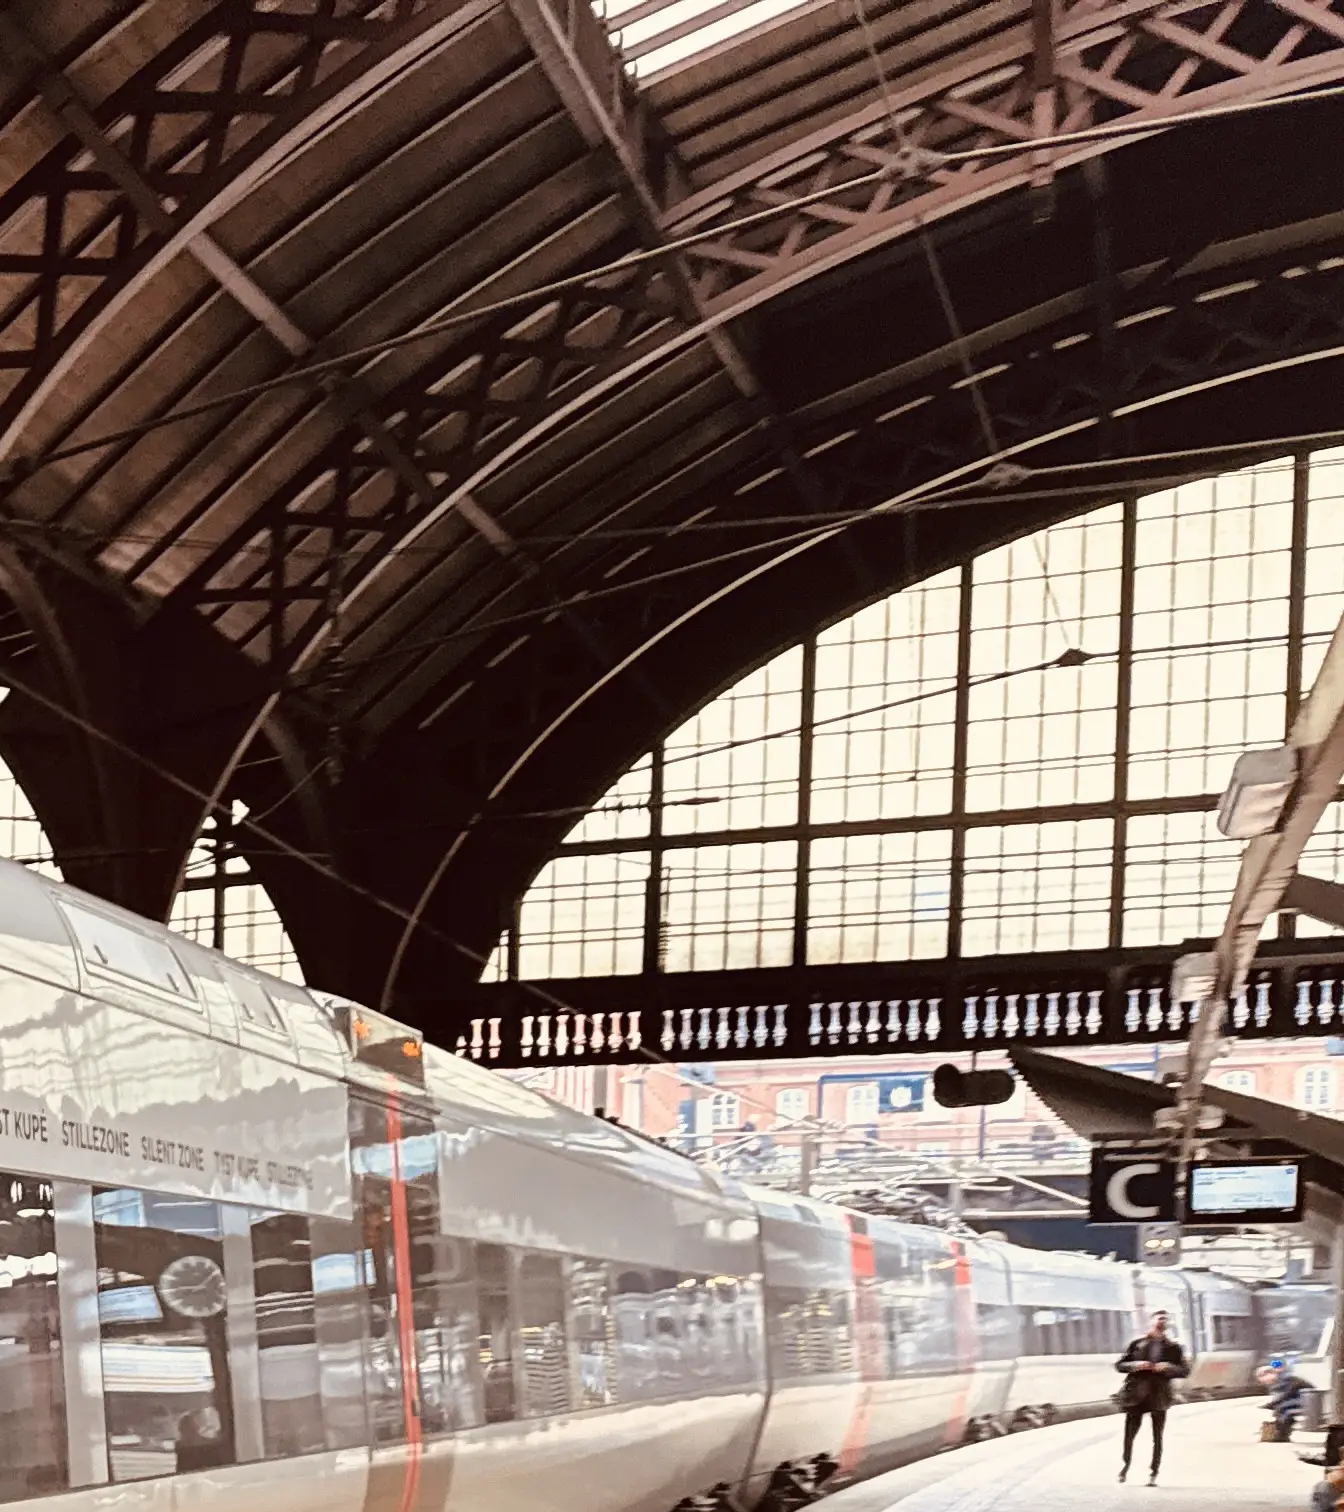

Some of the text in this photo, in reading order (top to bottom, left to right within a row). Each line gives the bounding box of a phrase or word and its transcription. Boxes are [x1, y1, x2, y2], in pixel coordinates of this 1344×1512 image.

[14, 1108, 48, 1143] KUPÉ
[62, 1120, 130, 1157] STILLEZONE
[141, 1136, 176, 1164] SILENT
[178, 1143, 205, 1172] ZONE
[1106, 1163, 1160, 1219] C
